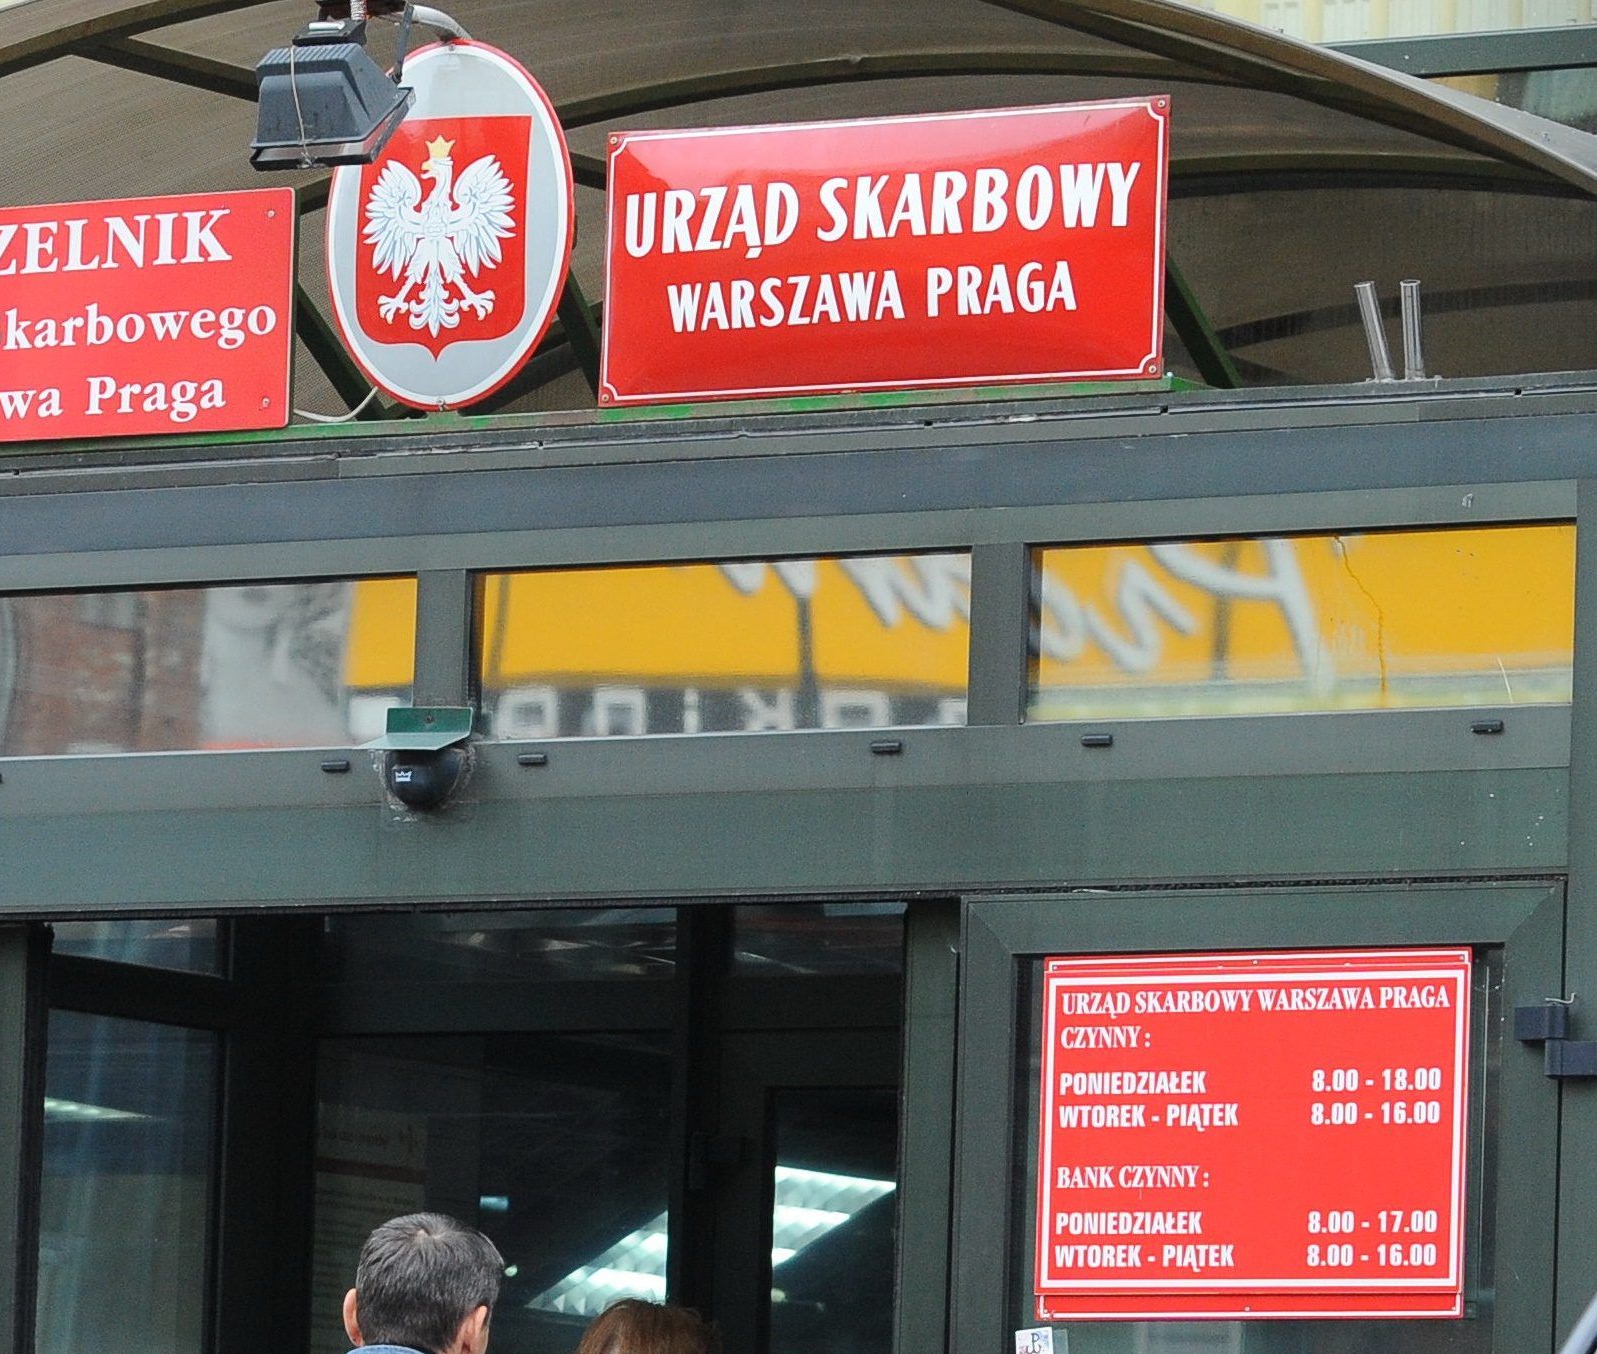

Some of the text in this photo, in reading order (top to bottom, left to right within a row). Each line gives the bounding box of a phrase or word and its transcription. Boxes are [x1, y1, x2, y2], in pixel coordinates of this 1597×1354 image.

[625, 161, 1141, 259] URZĄD SKARBOWY
[667, 260, 1077, 333] WARSZAWA PRAGA
[84, 376, 227, 423] Praga
[1062, 985, 1451, 1020] URZĄD SKARBOWY WARSZAWA PRAGA
[1059, 1070, 1207, 1096] PONIEDZIAŁEK
[1312, 1068, 1359, 1092] 8.00
[1381, 1067, 1442, 1091] 18.00
[1059, 1104, 1146, 1129] WTOREK
[1166, 1103, 1239, 1132] PIĄTEK
[1311, 1101, 1358, 1126] 8.00
[1381, 1100, 1441, 1124] 16.00
[1056, 1166, 1115, 1189] BANK
[1055, 1211, 1203, 1235] PONIEDZIAŁEK
[1307, 1210, 1355, 1234] 8.00
[1377, 1209, 1438, 1233] 17.00
[1054, 1244, 1142, 1268] WTOREK
[1162, 1244, 1235, 1273] PIĄTEK
[1306, 1243, 1354, 1267] 8.00
[1377, 1243, 1437, 1267] 16.00
